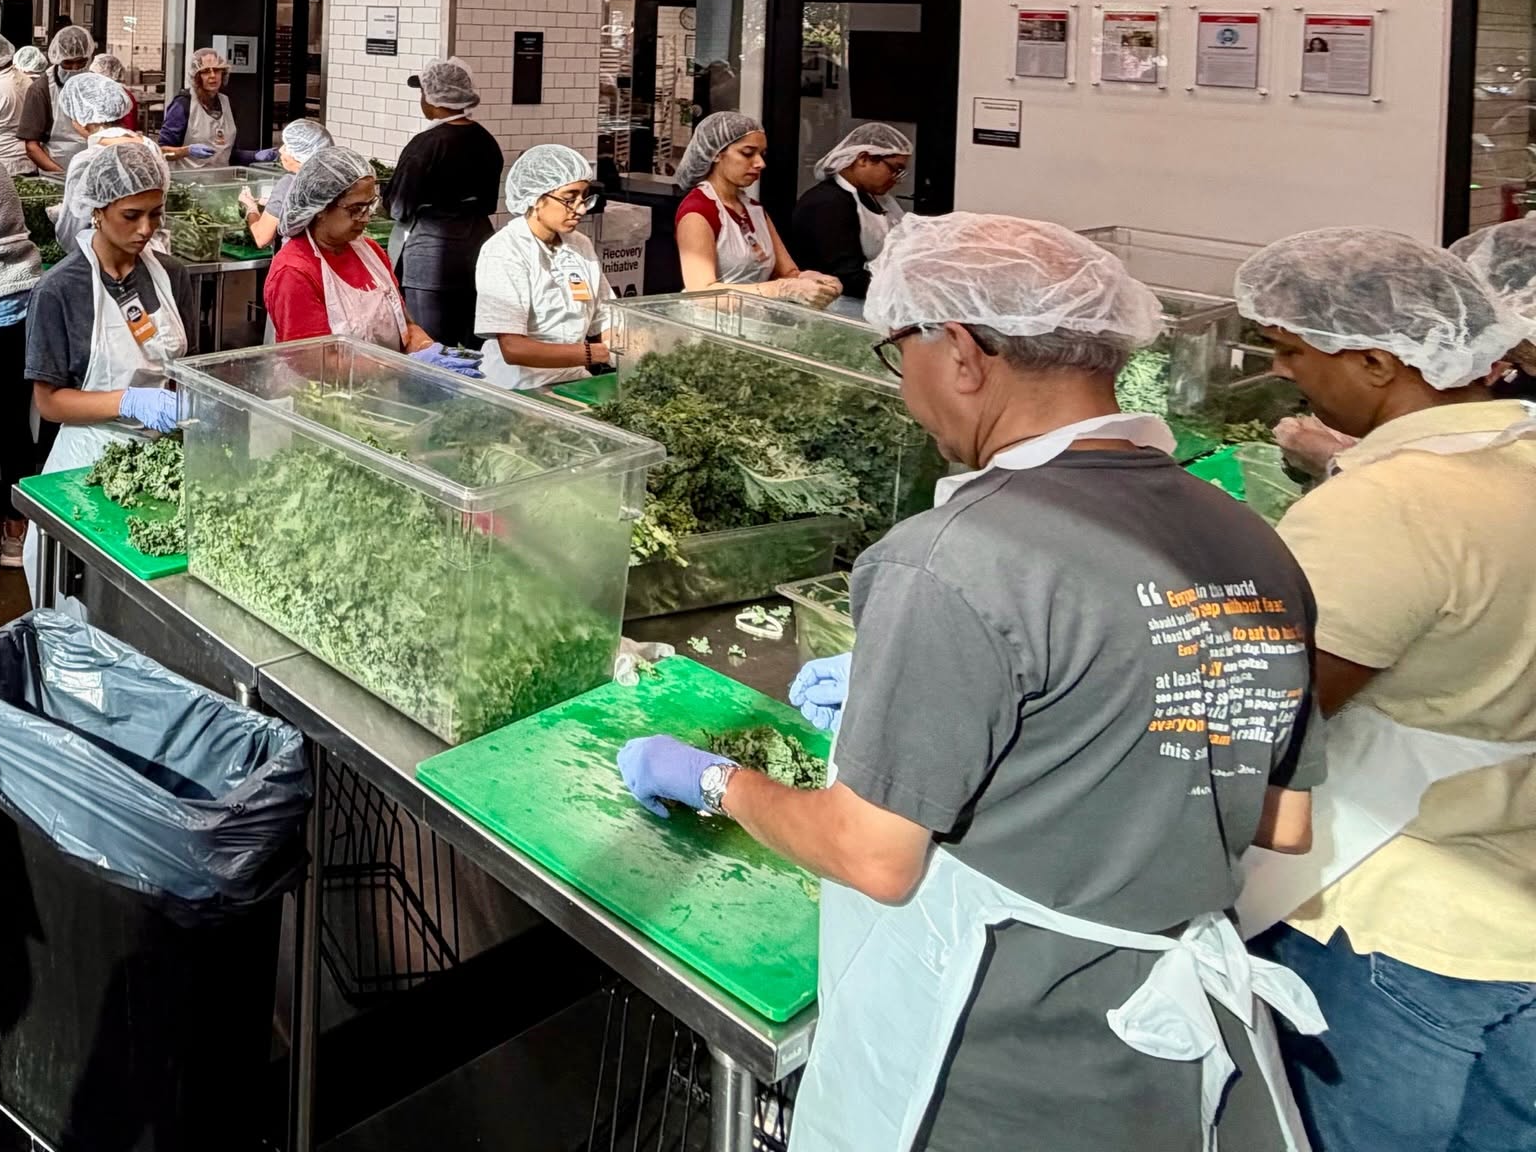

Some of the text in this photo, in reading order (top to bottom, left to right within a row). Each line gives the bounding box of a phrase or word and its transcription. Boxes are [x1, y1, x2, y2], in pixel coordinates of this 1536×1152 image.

[603, 246, 643, 259] Recovery
[602, 260, 638, 273] Initiative
[1224, 580, 1258, 597] world
[1232, 627, 1247, 640] to
[1155, 675, 1171, 689] at
[1173, 668, 1202, 686] least
[1148, 718, 1206, 732] everyon
[1159, 742, 1192, 760] this
